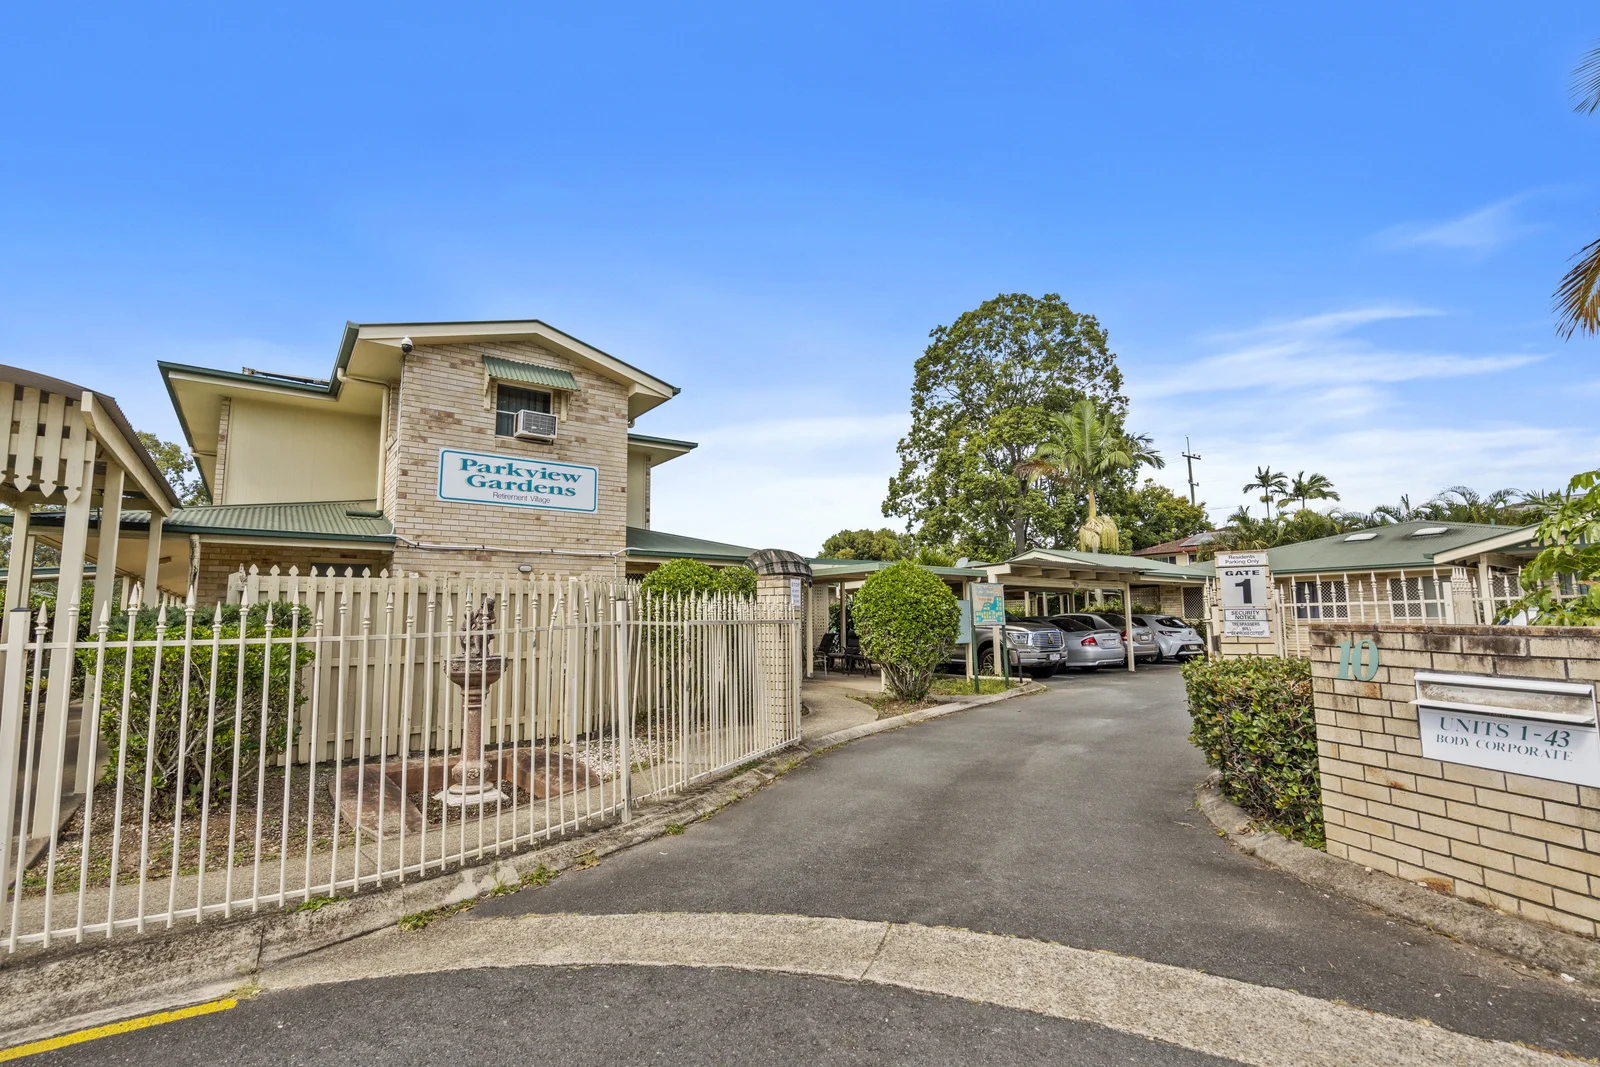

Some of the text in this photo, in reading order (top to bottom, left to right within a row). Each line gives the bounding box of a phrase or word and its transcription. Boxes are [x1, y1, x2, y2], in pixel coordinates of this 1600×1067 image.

[459, 457, 582, 483] Parkview
[467, 474, 577, 497] Gardens
[492, 492, 551, 504] Retirement Village
[1235, 578, 1253, 604] 1
[1335, 639, 1380, 682] 10
[1440, 716, 1510, 739] UNITS
[1435, 733, 1573, 762] BODY CORPORATE
